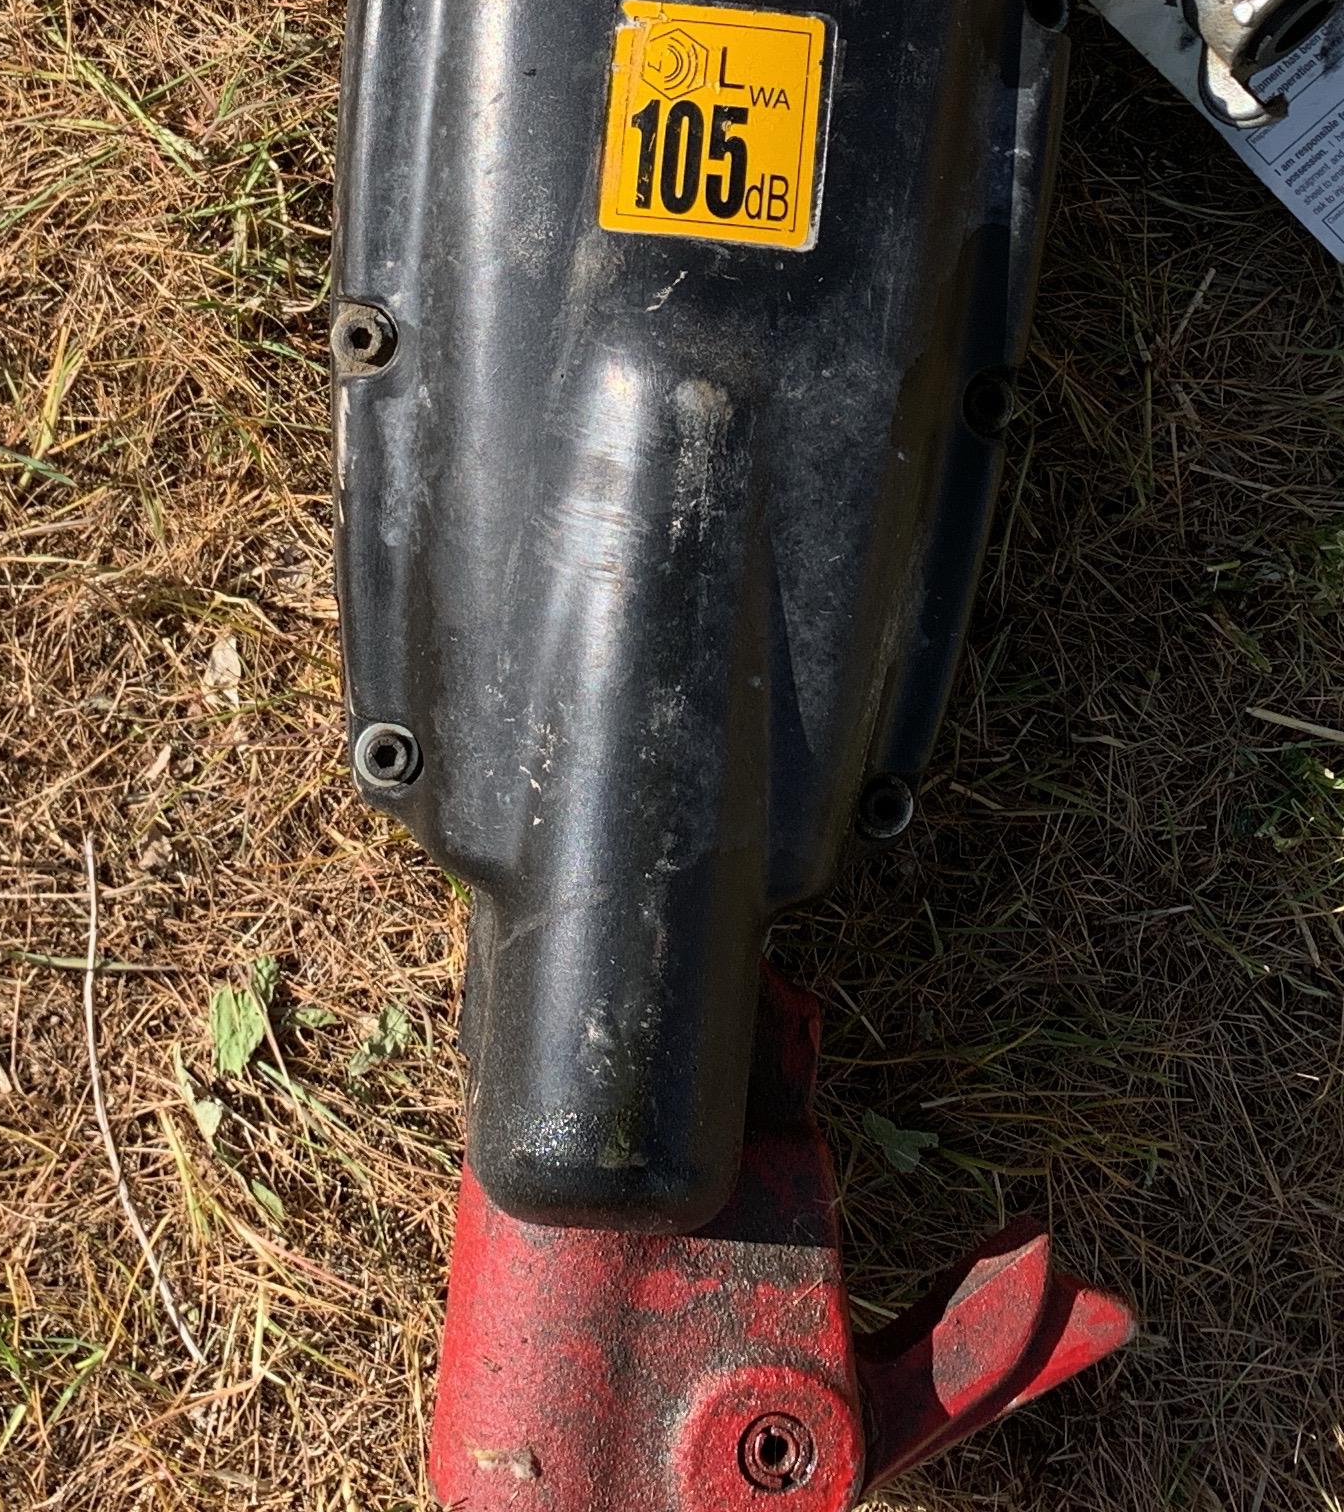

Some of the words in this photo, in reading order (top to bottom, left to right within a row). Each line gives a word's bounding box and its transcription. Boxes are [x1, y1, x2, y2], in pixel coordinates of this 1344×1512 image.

[1281, 52, 1301, 68] has
[1297, 34, 1321, 54] been
[1277, 59, 1317, 95] operation
[1273, 168, 1282, 176] I
[1280, 157, 1296, 171] am
[1294, 119, 1339, 159] responsible
[1284, 149, 1328, 187] possession.
[1327, 139, 1335, 148] I
[1294, 162, 1331, 195] equipment
[1321, 179, 1332, 189] to
[1312, 201, 1327, 215] risk
[1323, 194, 1335, 204] to
